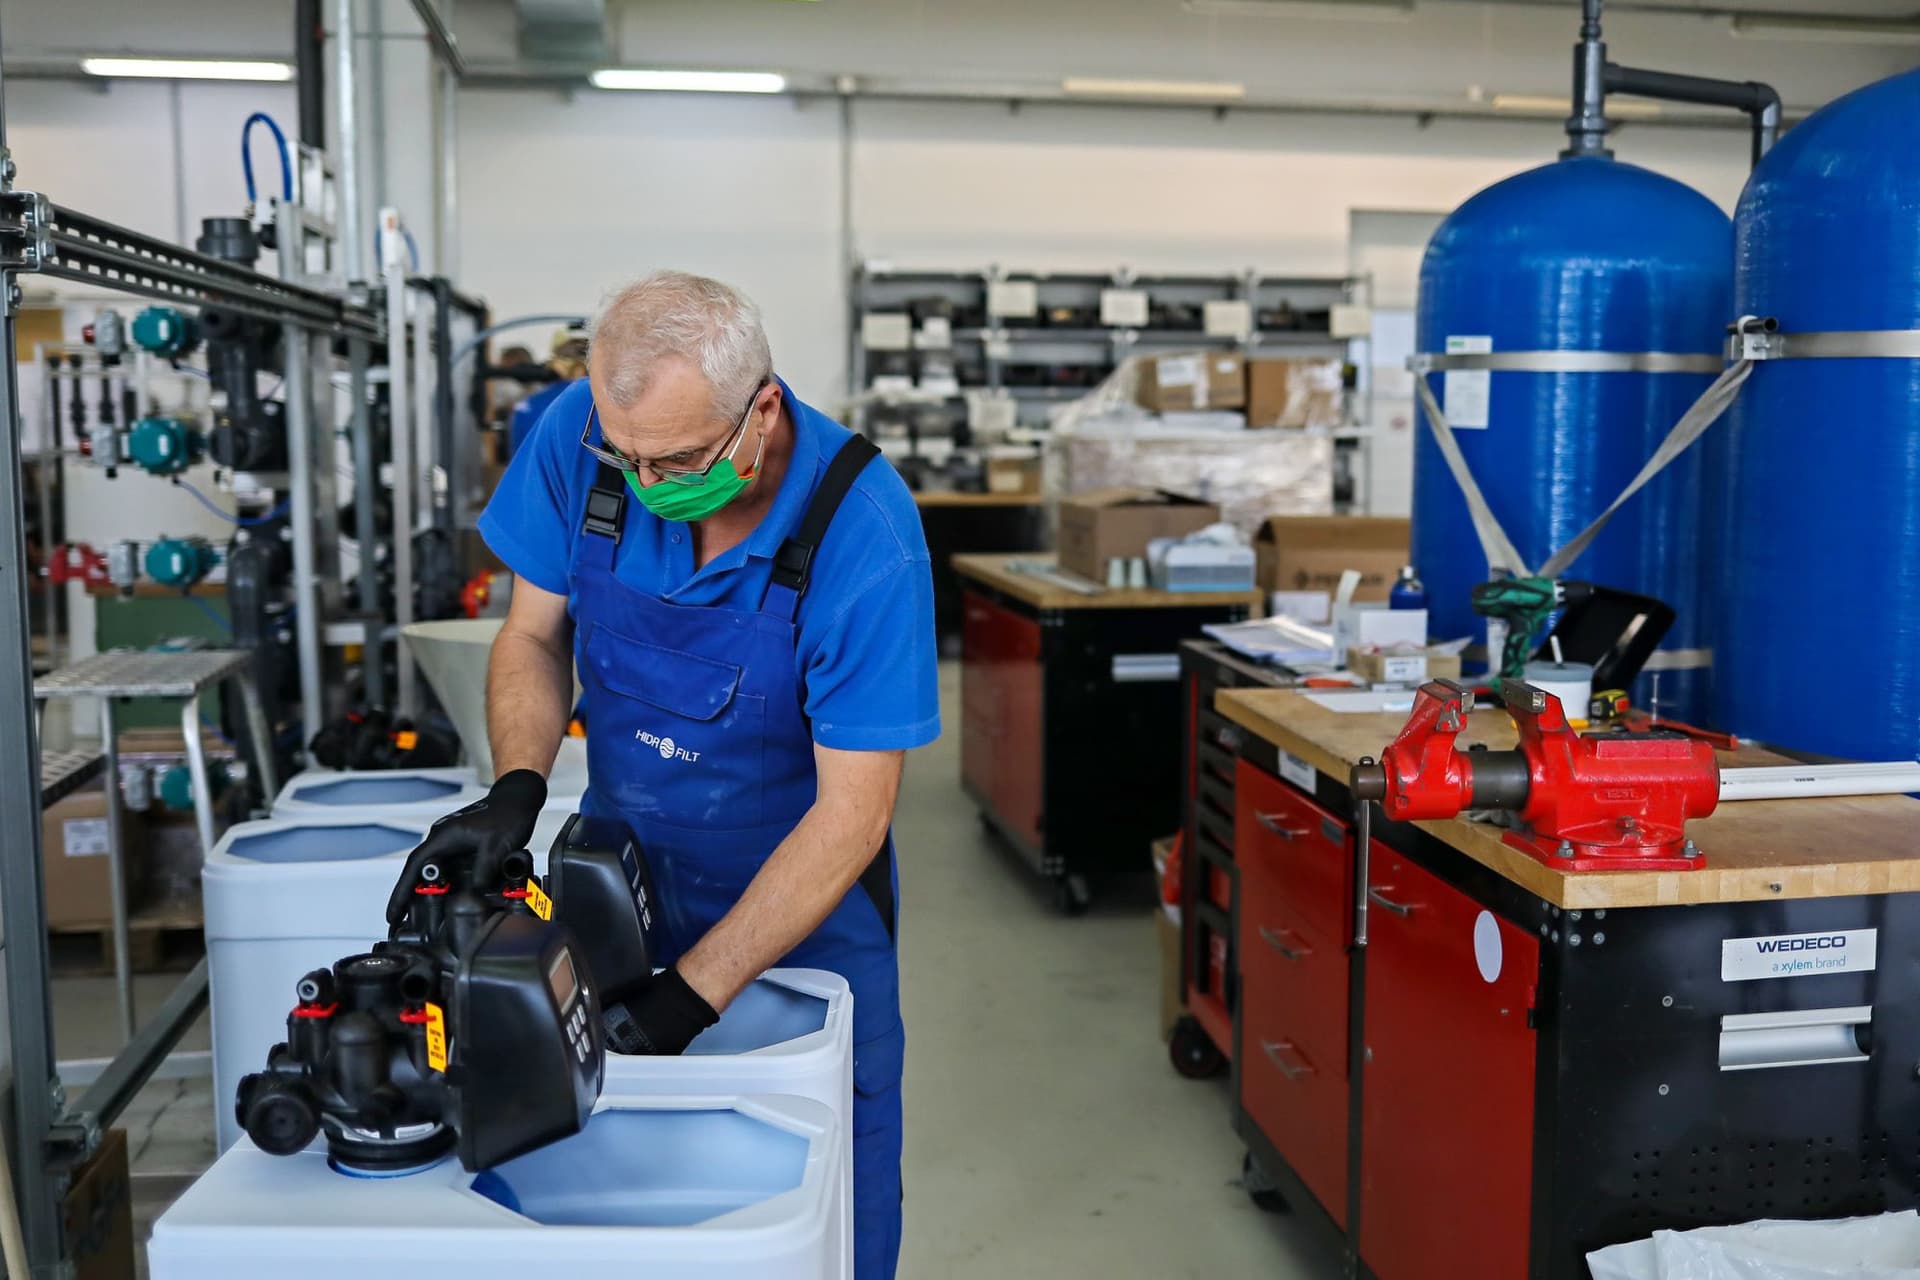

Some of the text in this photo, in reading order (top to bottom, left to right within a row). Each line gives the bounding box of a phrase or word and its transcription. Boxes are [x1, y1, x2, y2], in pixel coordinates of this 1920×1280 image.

[1757, 935, 1847, 953] WEDECO
[1772, 956, 1847, 973] a xylem brand
